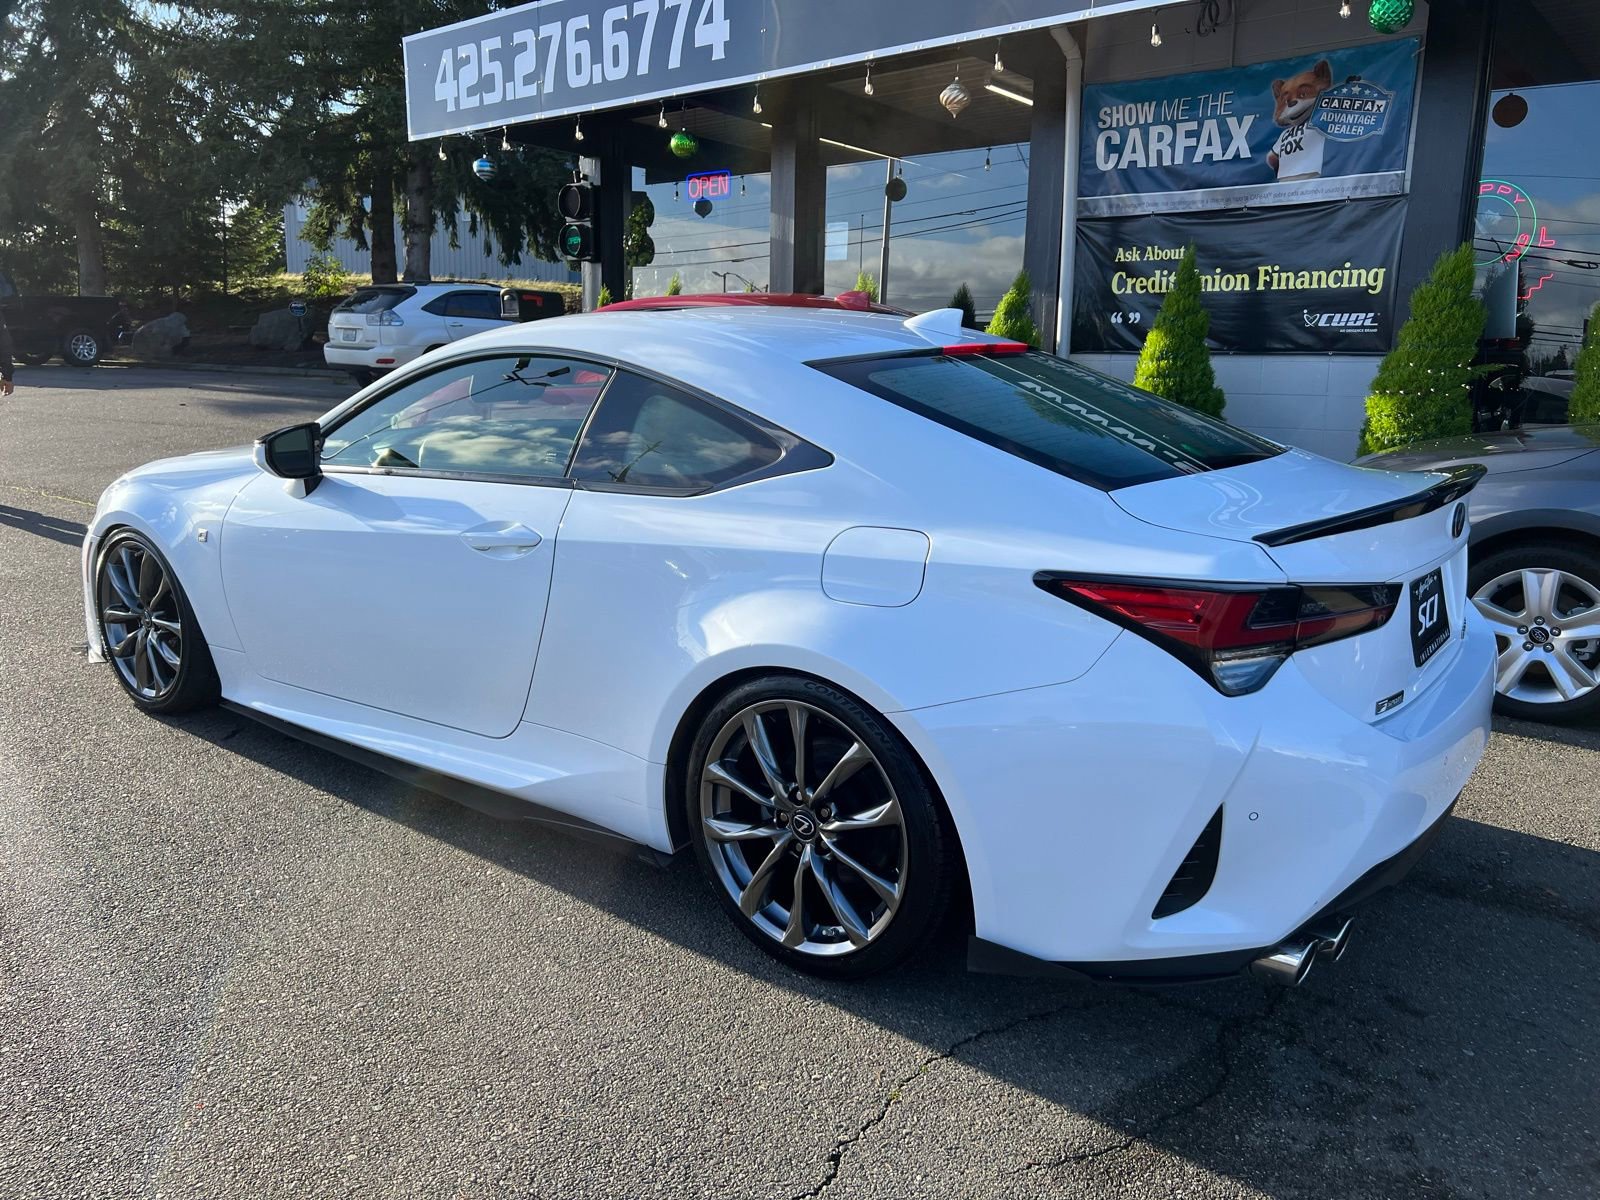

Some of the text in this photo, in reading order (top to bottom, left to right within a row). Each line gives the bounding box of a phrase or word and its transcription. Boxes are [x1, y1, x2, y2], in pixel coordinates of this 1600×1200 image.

[435, 0, 730, 112] 425.276.6774
[1098, 91, 1235, 129] SHOW ME THE
[1321, 98, 1384, 112] CARFAX
[1320, 111, 1377, 125] ADVANTAGE
[1282, 123, 1305, 142] CAR
[1327, 124, 1364, 135] DEALER
[1095, 115, 1256, 171] CARFAX
[1280, 137, 1304, 157] FOX
[688, 174, 729, 198] OPEN
[1480, 184, 1527, 203] PPY
[1115, 245, 1186, 262] Ask About
[1111, 261, 1386, 295] Credit nion Financing
[803, 681, 892, 748] CONTINEN
